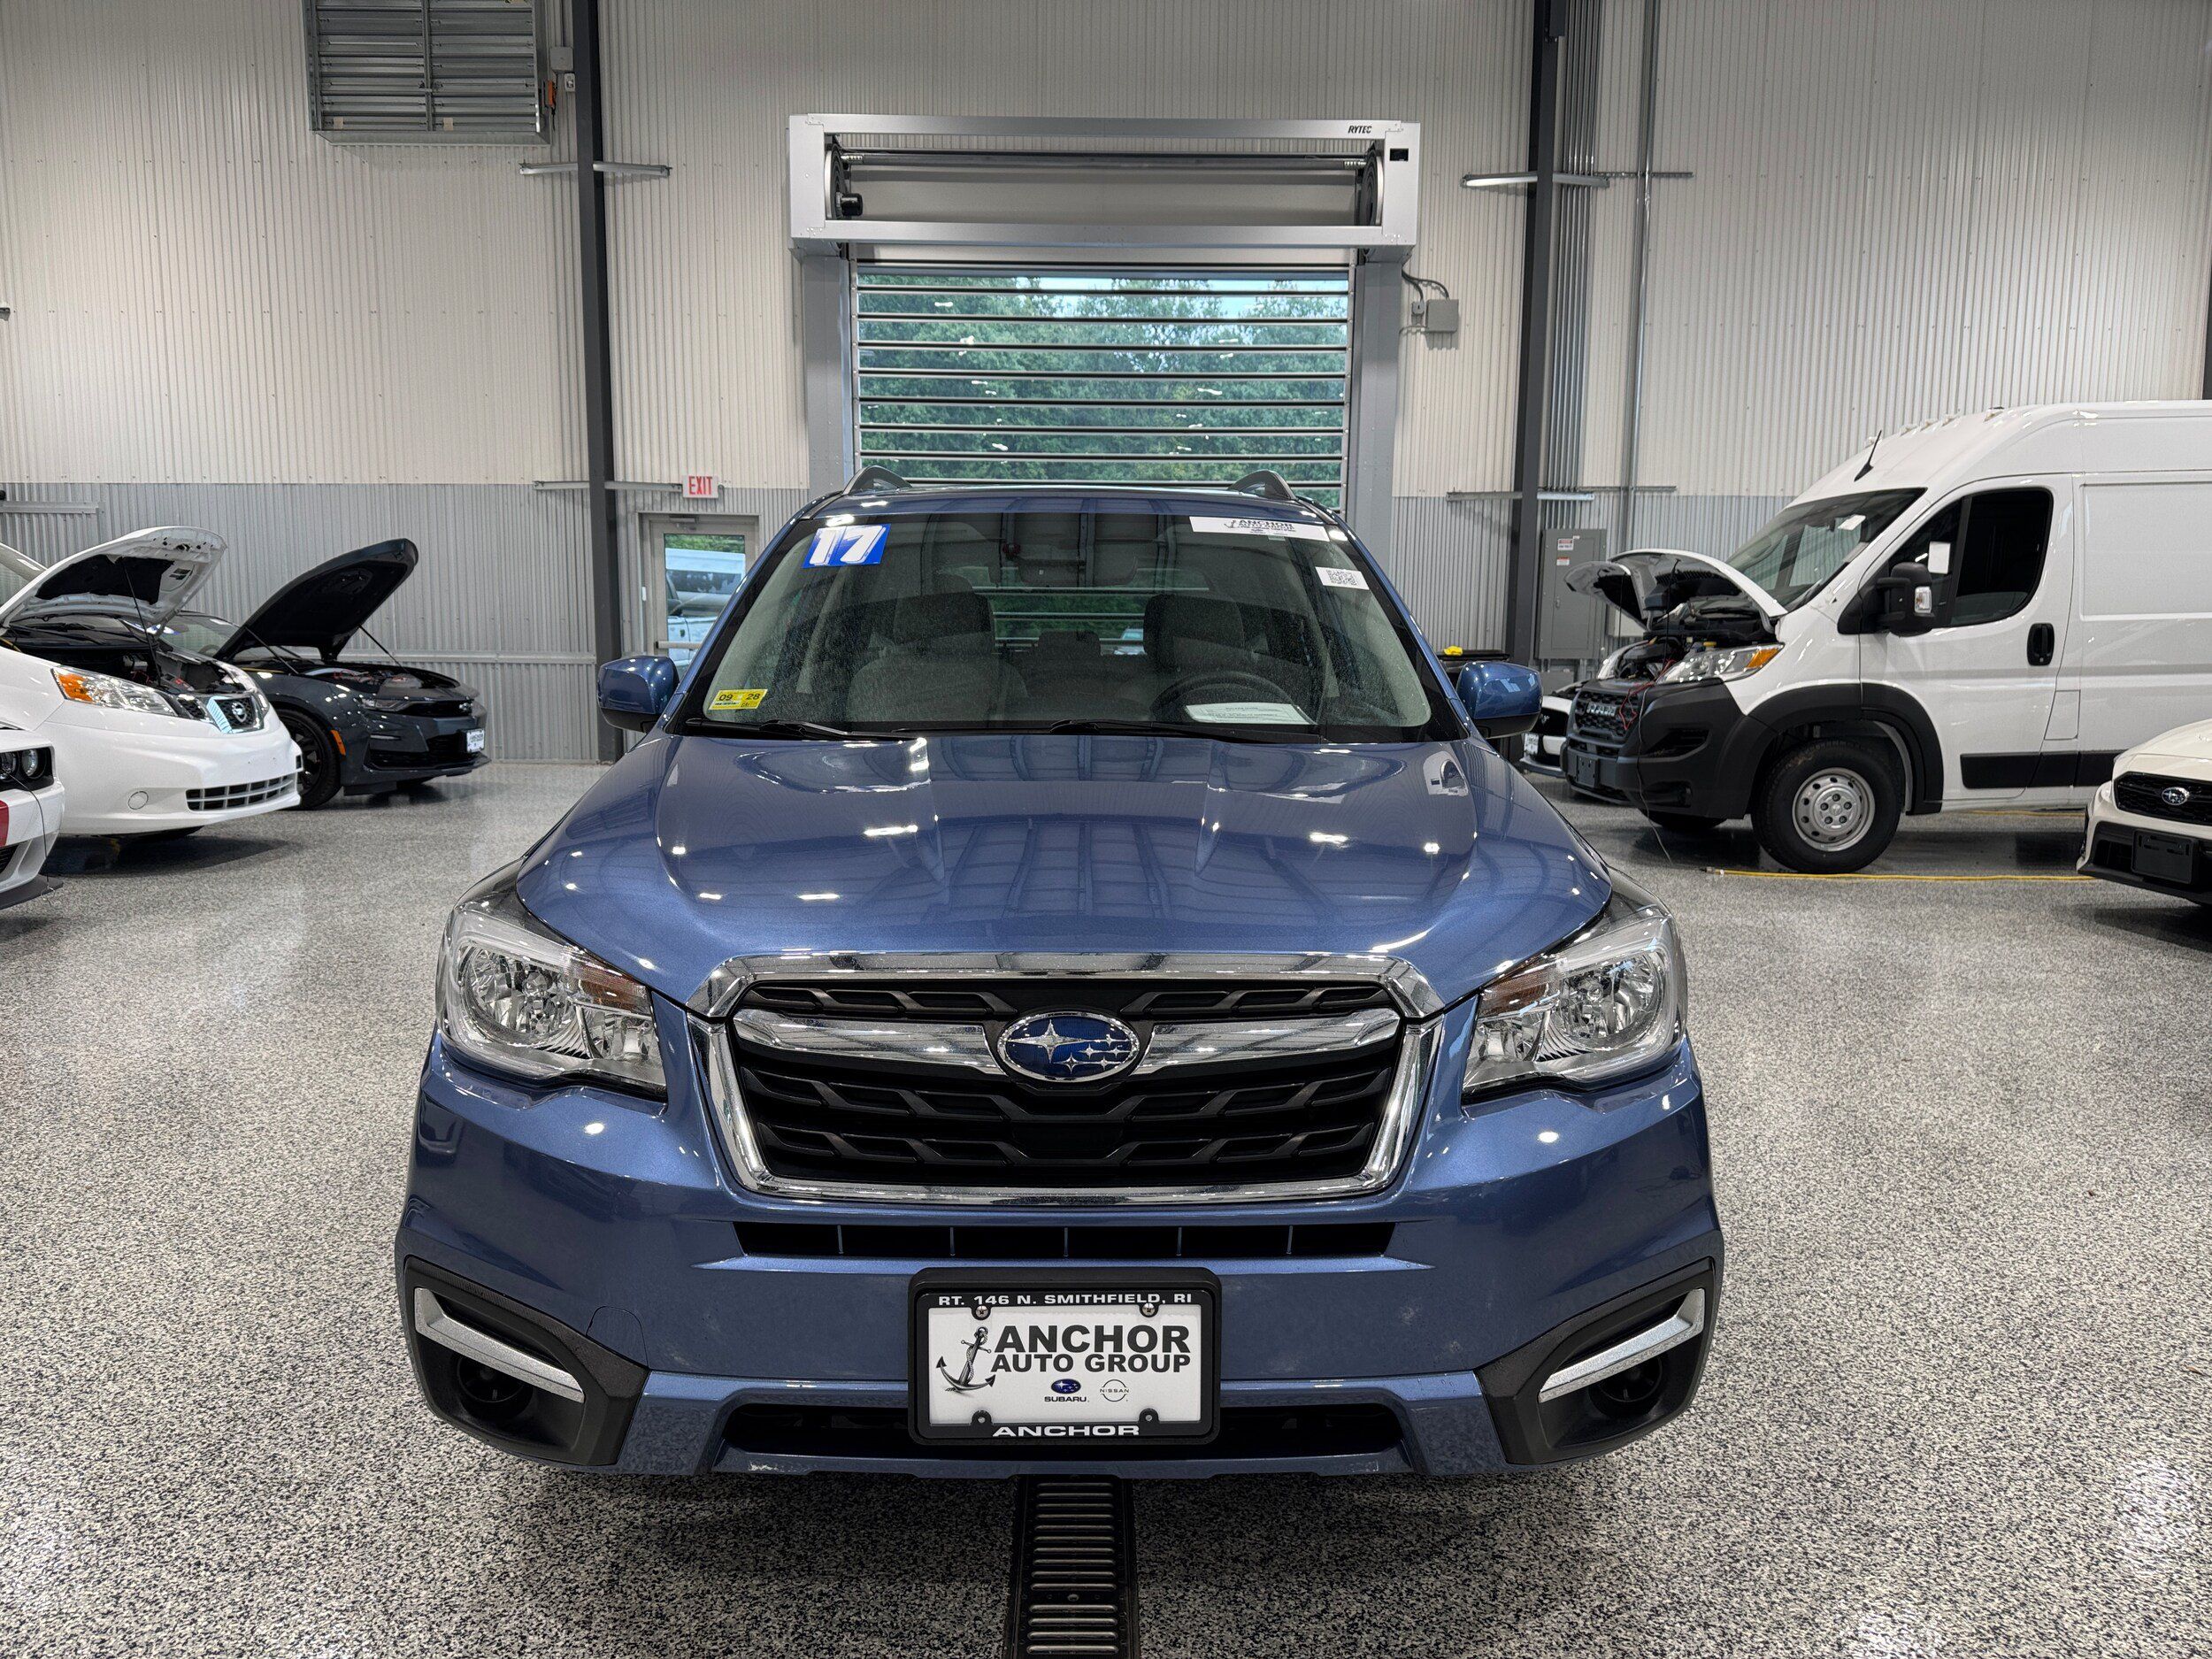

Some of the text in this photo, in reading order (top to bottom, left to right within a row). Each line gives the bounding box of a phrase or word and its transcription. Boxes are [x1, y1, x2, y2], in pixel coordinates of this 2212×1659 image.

[1348, 125, 1372, 134] RYTEC
[688, 476, 712, 495] EXIT
[809, 525, 887, 566] 17
[939, 1294, 1192, 1305] RT. 146 N. SMITHFIELD, RI
[995, 1325, 1191, 1353] ANCHOR
[990, 1354, 1191, 1372] AUTO GROUP
[992, 1425, 1140, 1437] ANCHOR
